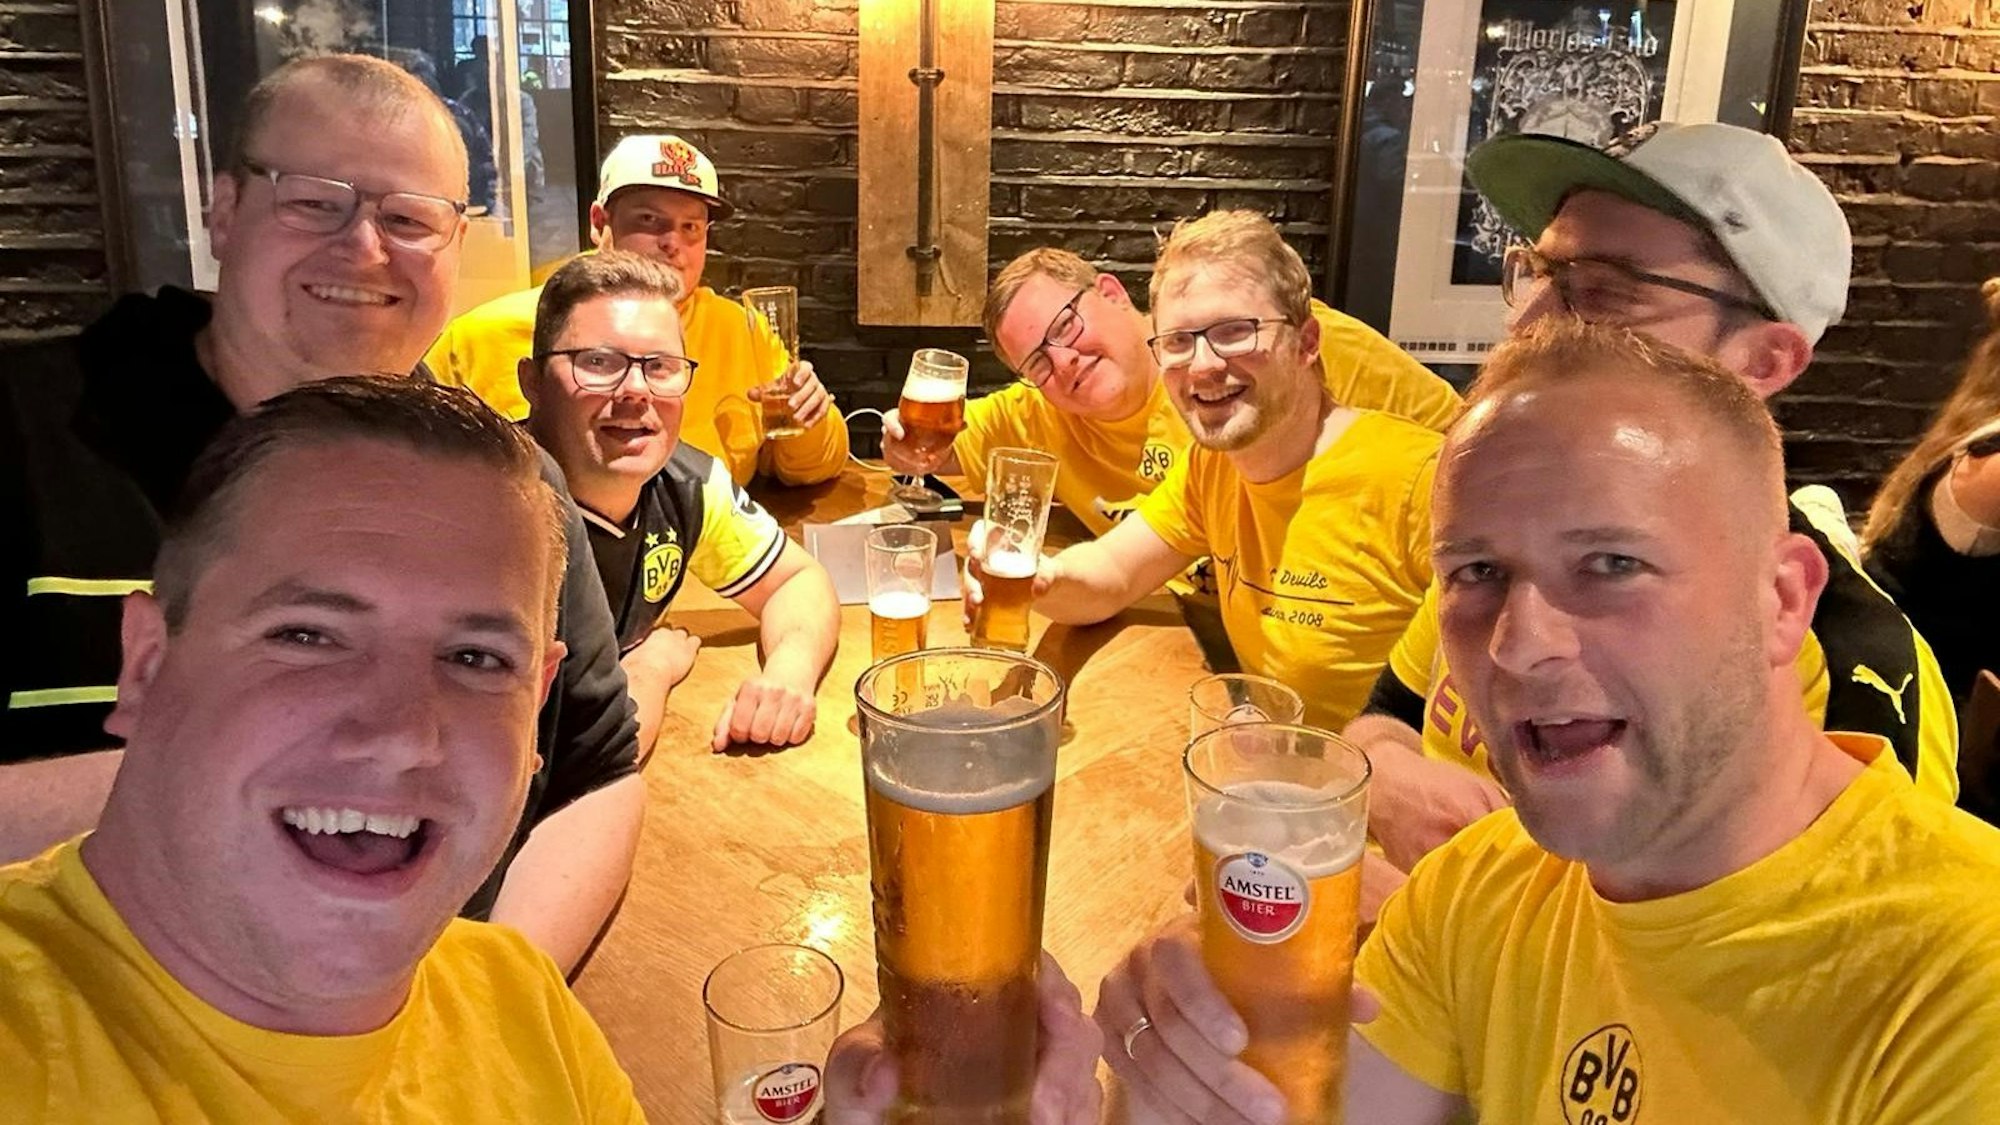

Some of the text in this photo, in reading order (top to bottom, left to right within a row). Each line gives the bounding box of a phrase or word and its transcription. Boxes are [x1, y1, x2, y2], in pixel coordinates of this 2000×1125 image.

[1144, 446, 1170, 477] BVB
[647, 551, 681, 591] BVB
[1280, 569, 1329, 590] Devils
[1288, 610, 1324, 627] 2008
[1224, 876, 1295, 900] AMSTEL
[1242, 900, 1276, 916] BIER
[761, 1078, 811, 1097] AMSTEL
[1569, 1033, 1638, 1122] BVB
